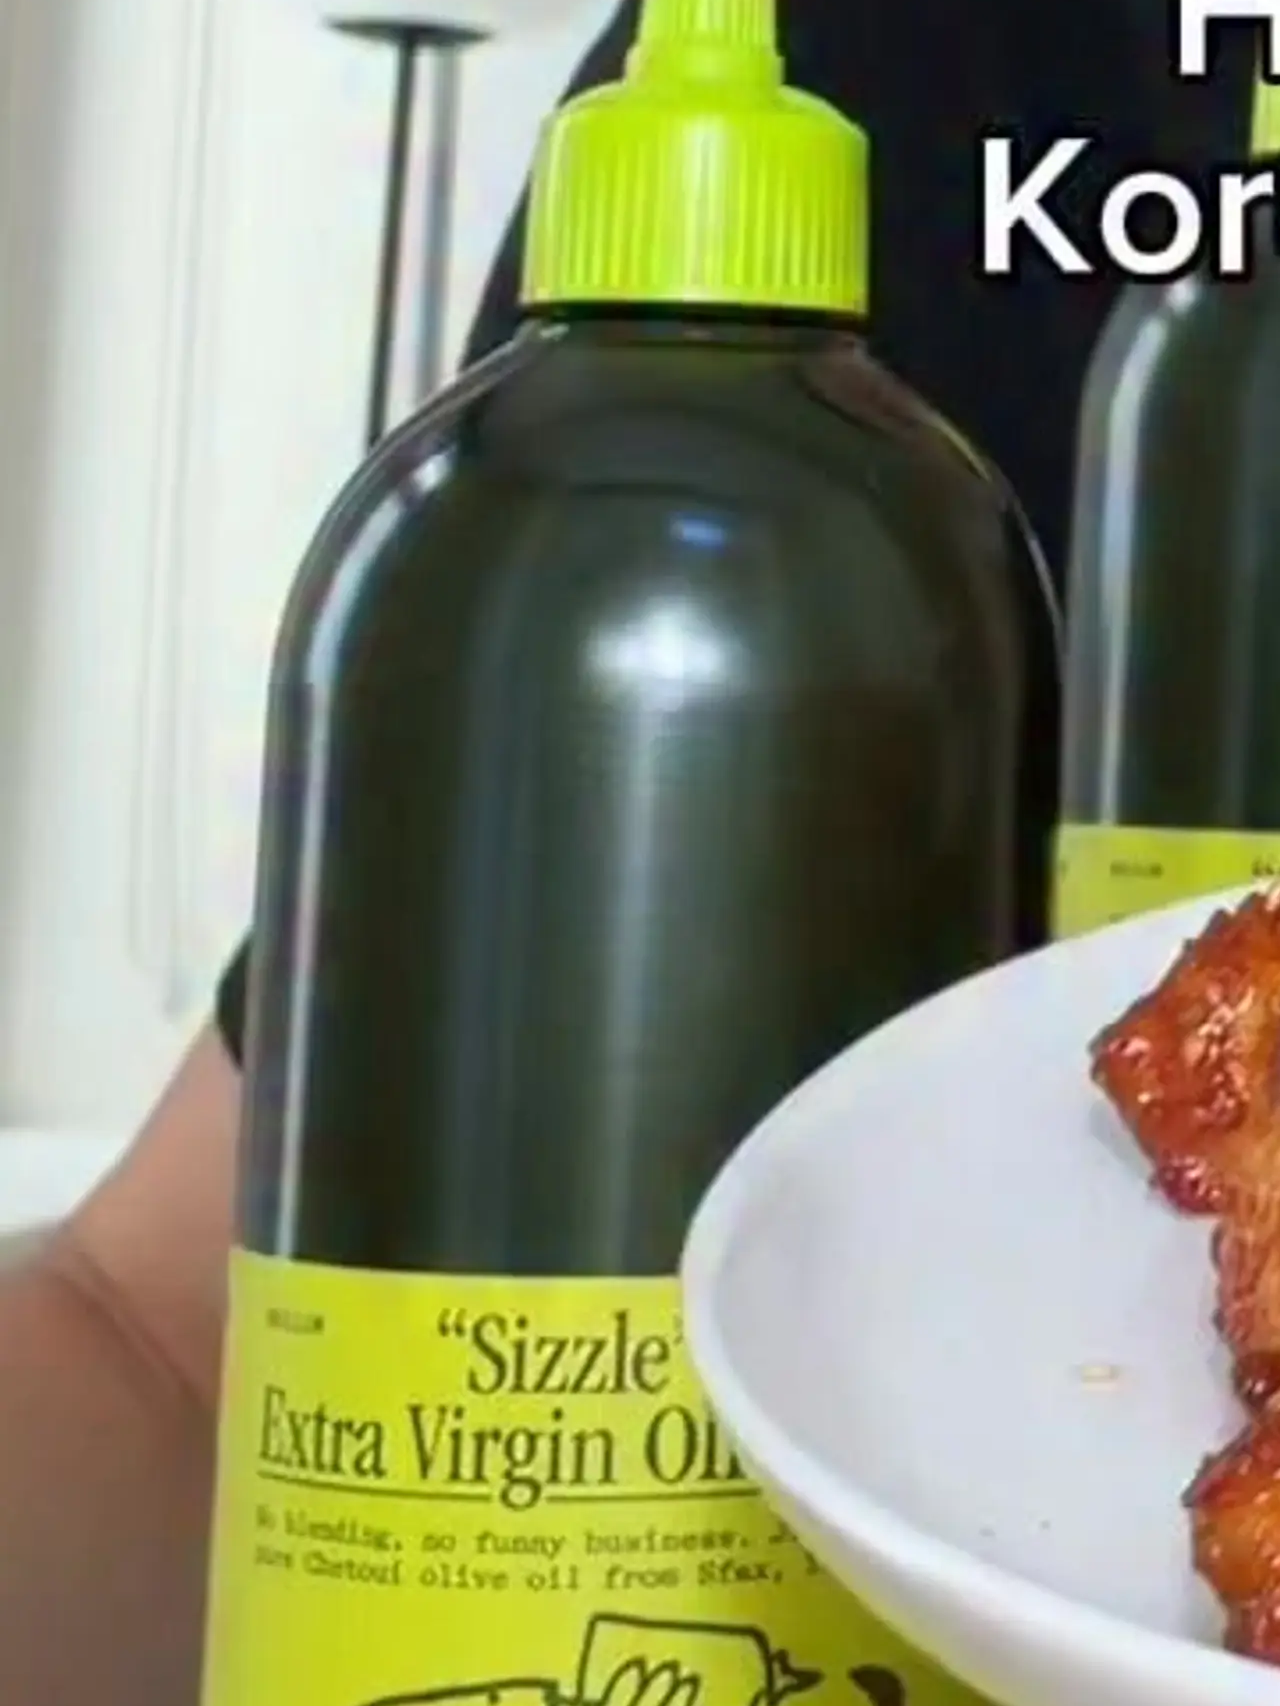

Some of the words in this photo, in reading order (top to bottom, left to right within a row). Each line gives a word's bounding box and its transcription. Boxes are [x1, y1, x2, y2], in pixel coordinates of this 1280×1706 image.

[259, 1388, 387, 1479] Extra
[408, 1404, 616, 1510] Virgin
[476, 1530, 565, 1559] funny
[419, 1563, 509, 1590] olive
[526, 1563, 579, 1590] oil
[605, 1564, 679, 1589] from
